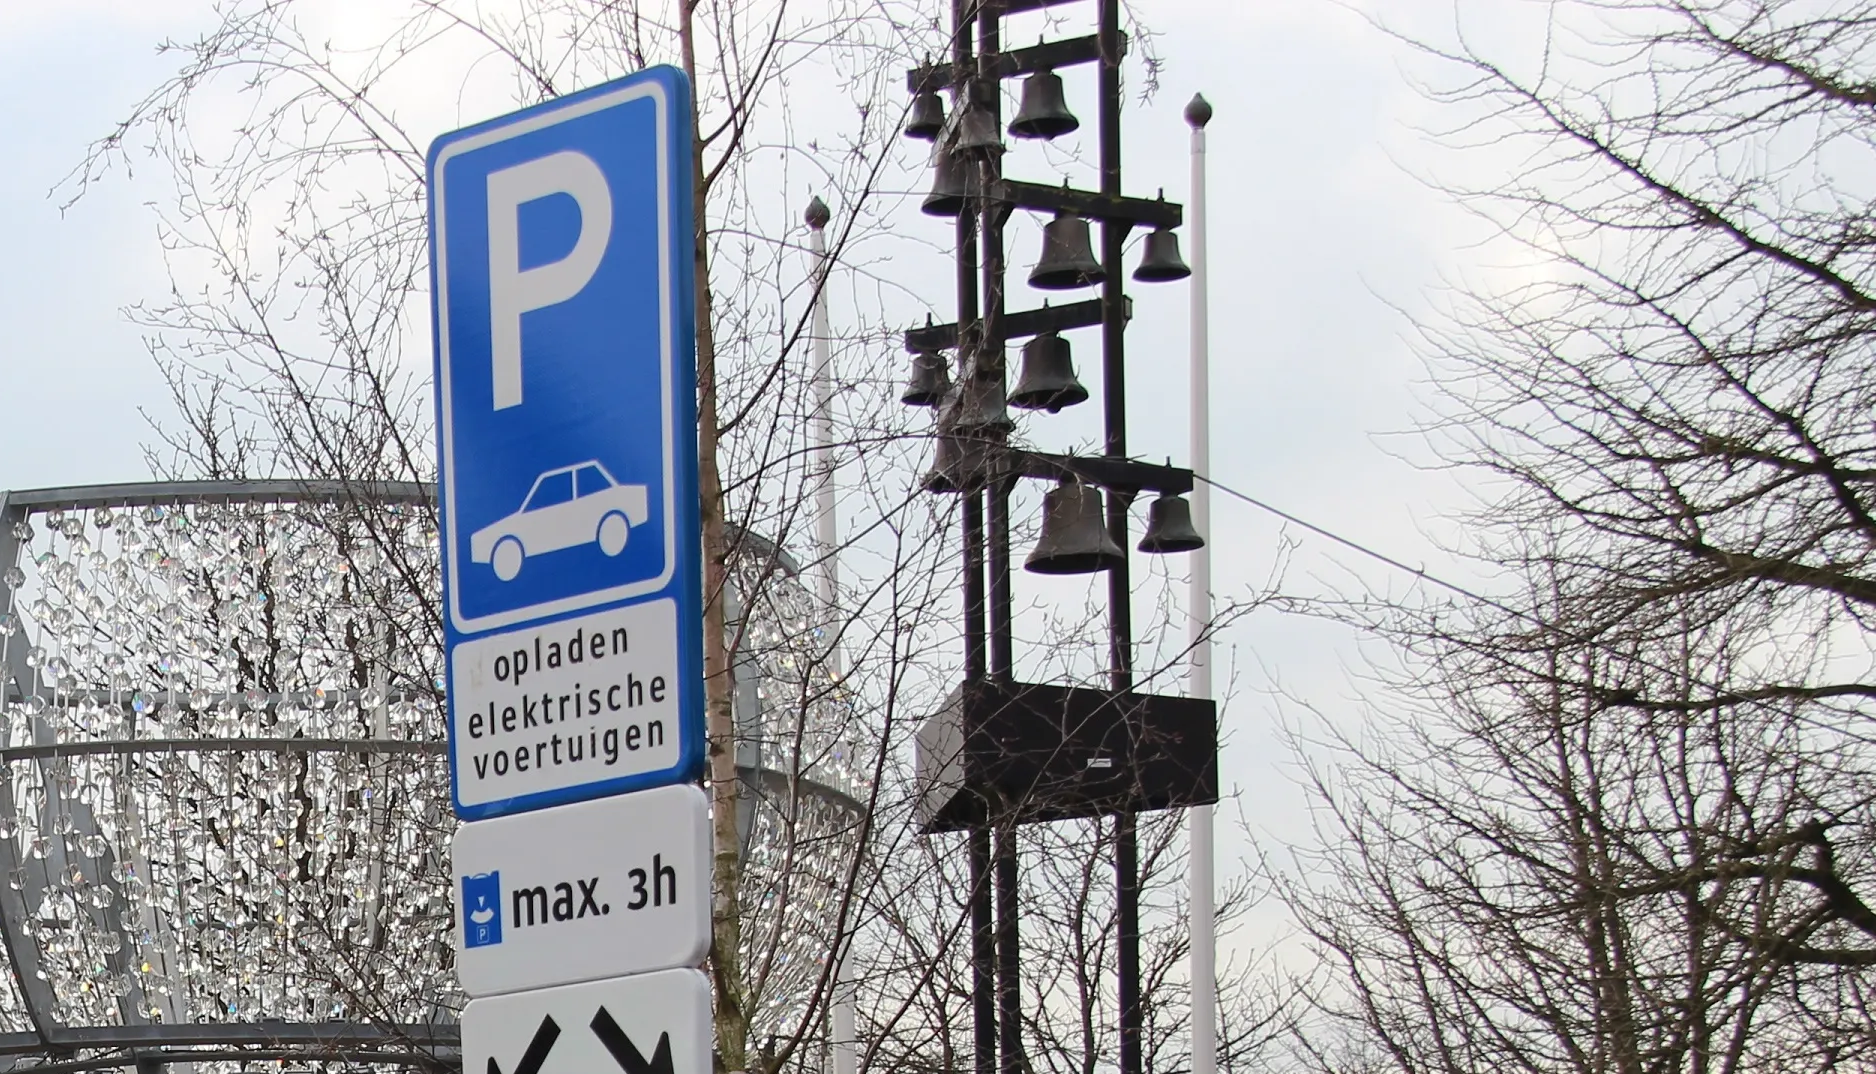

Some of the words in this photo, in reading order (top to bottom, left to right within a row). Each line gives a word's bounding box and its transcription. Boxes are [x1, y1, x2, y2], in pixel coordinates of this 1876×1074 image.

[487, 150, 613, 411] P
[494, 627, 628, 686] opladen
[468, 672, 666, 739] elektrische
[474, 719, 664, 780] voertuigen
[512, 877, 610, 928] max.
[627, 853, 677, 911] 3h
